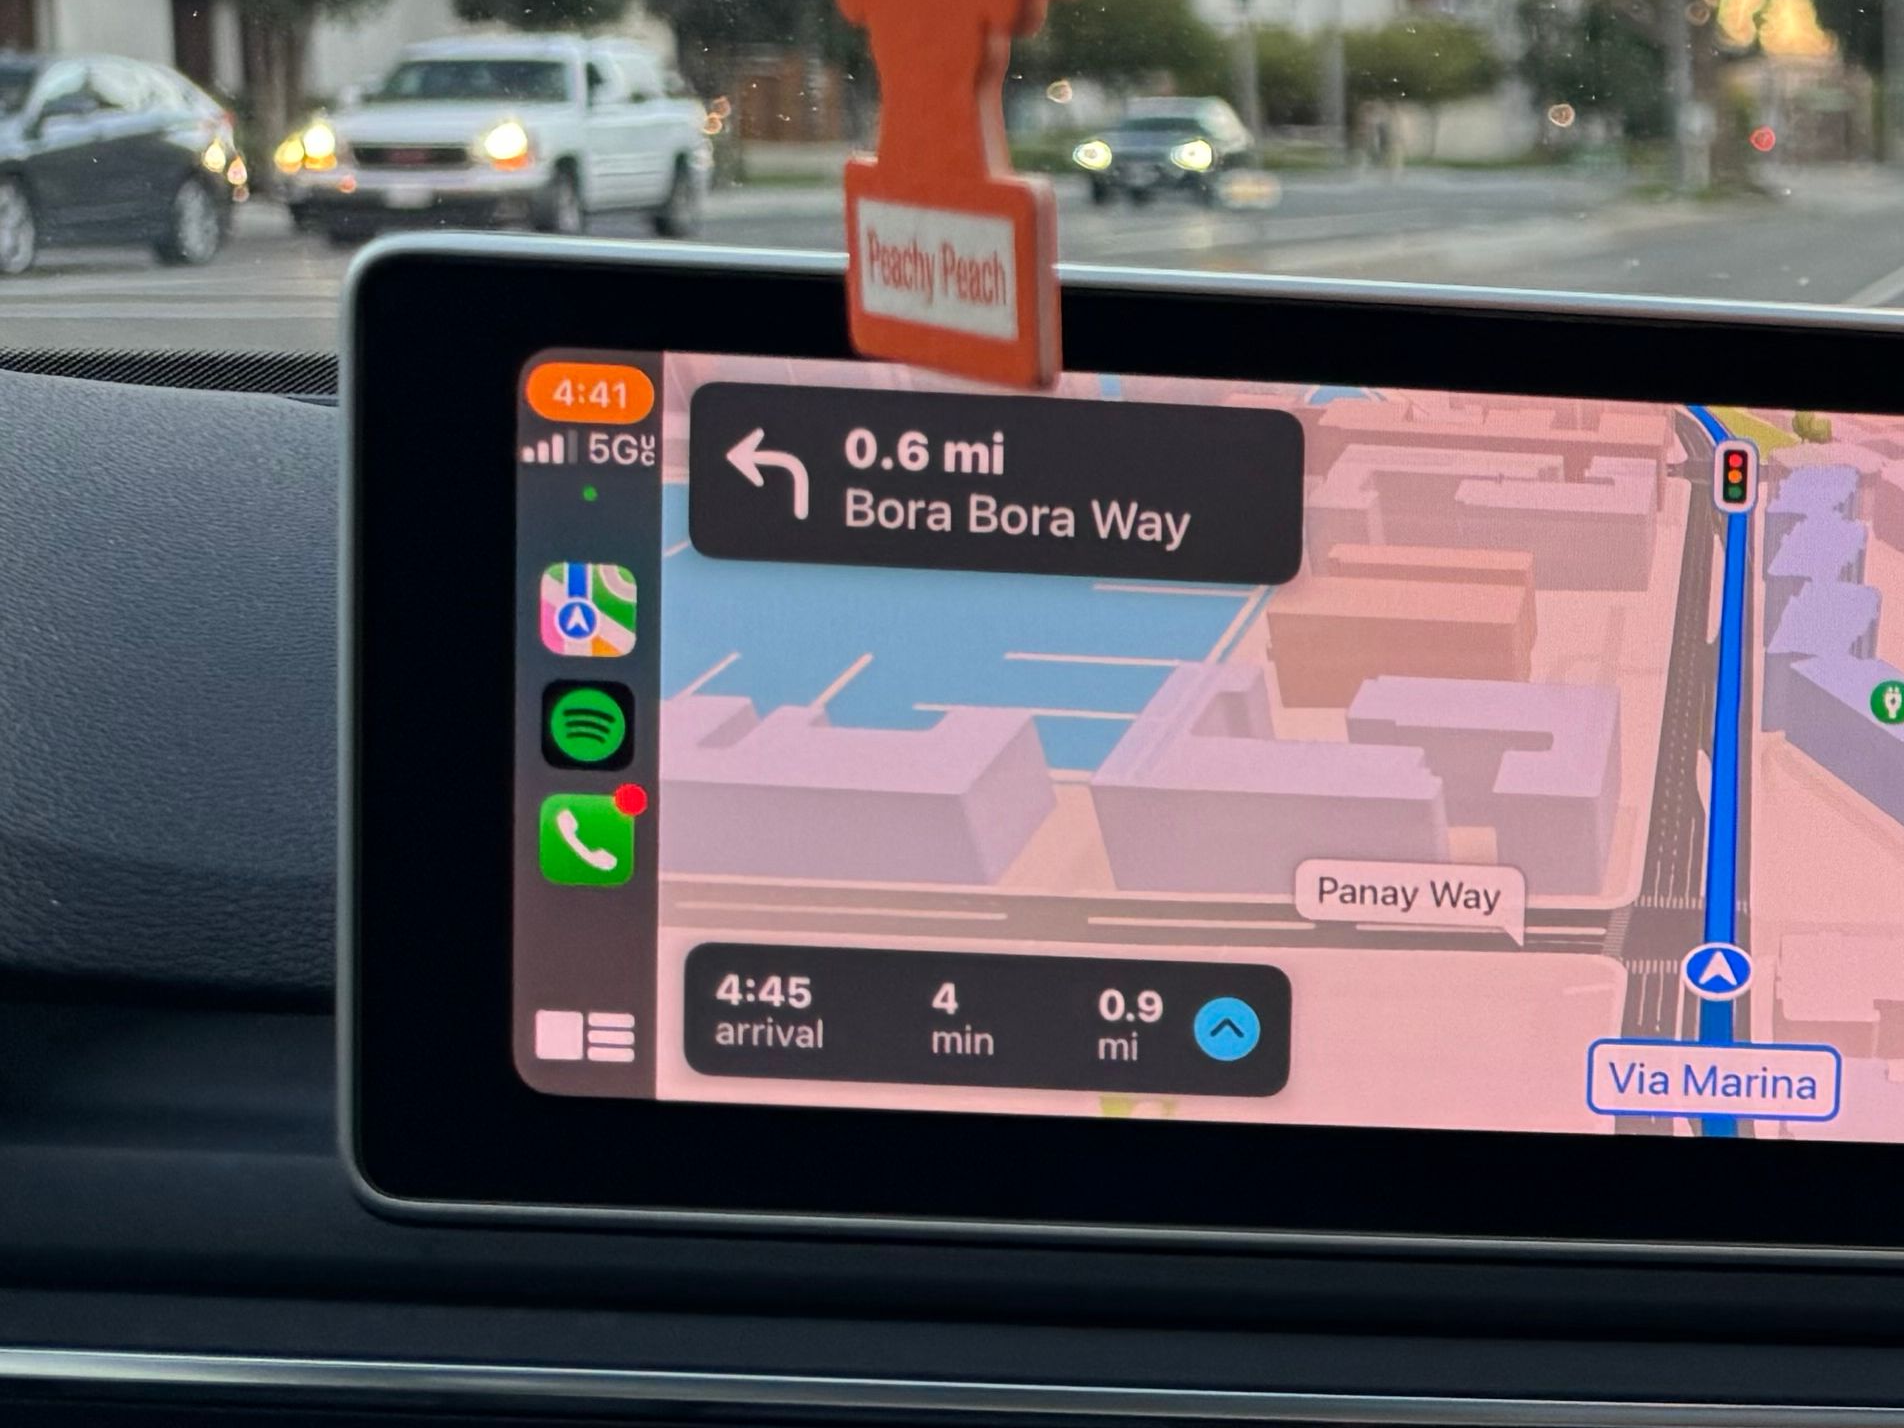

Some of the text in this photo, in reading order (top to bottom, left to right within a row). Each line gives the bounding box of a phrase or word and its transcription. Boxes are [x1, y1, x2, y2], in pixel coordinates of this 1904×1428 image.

[867, 228, 1008, 305] Peachy Peach
[553, 379, 628, 410] 4:41
[845, 429, 1005, 475] 0.6 mi
[845, 489, 1191, 551] Bora Bora Way
[1317, 877, 1501, 915] Panay Way
[715, 975, 811, 1008] 4:45
[932, 983, 958, 1014] 4
[1098, 990, 1163, 1023] 0.9
[715, 1015, 823, 1049] arrival
[932, 1024, 994, 1055] min
[1098, 1031, 1138, 1061] mi
[1609, 1062, 1817, 1100] Via Marina
